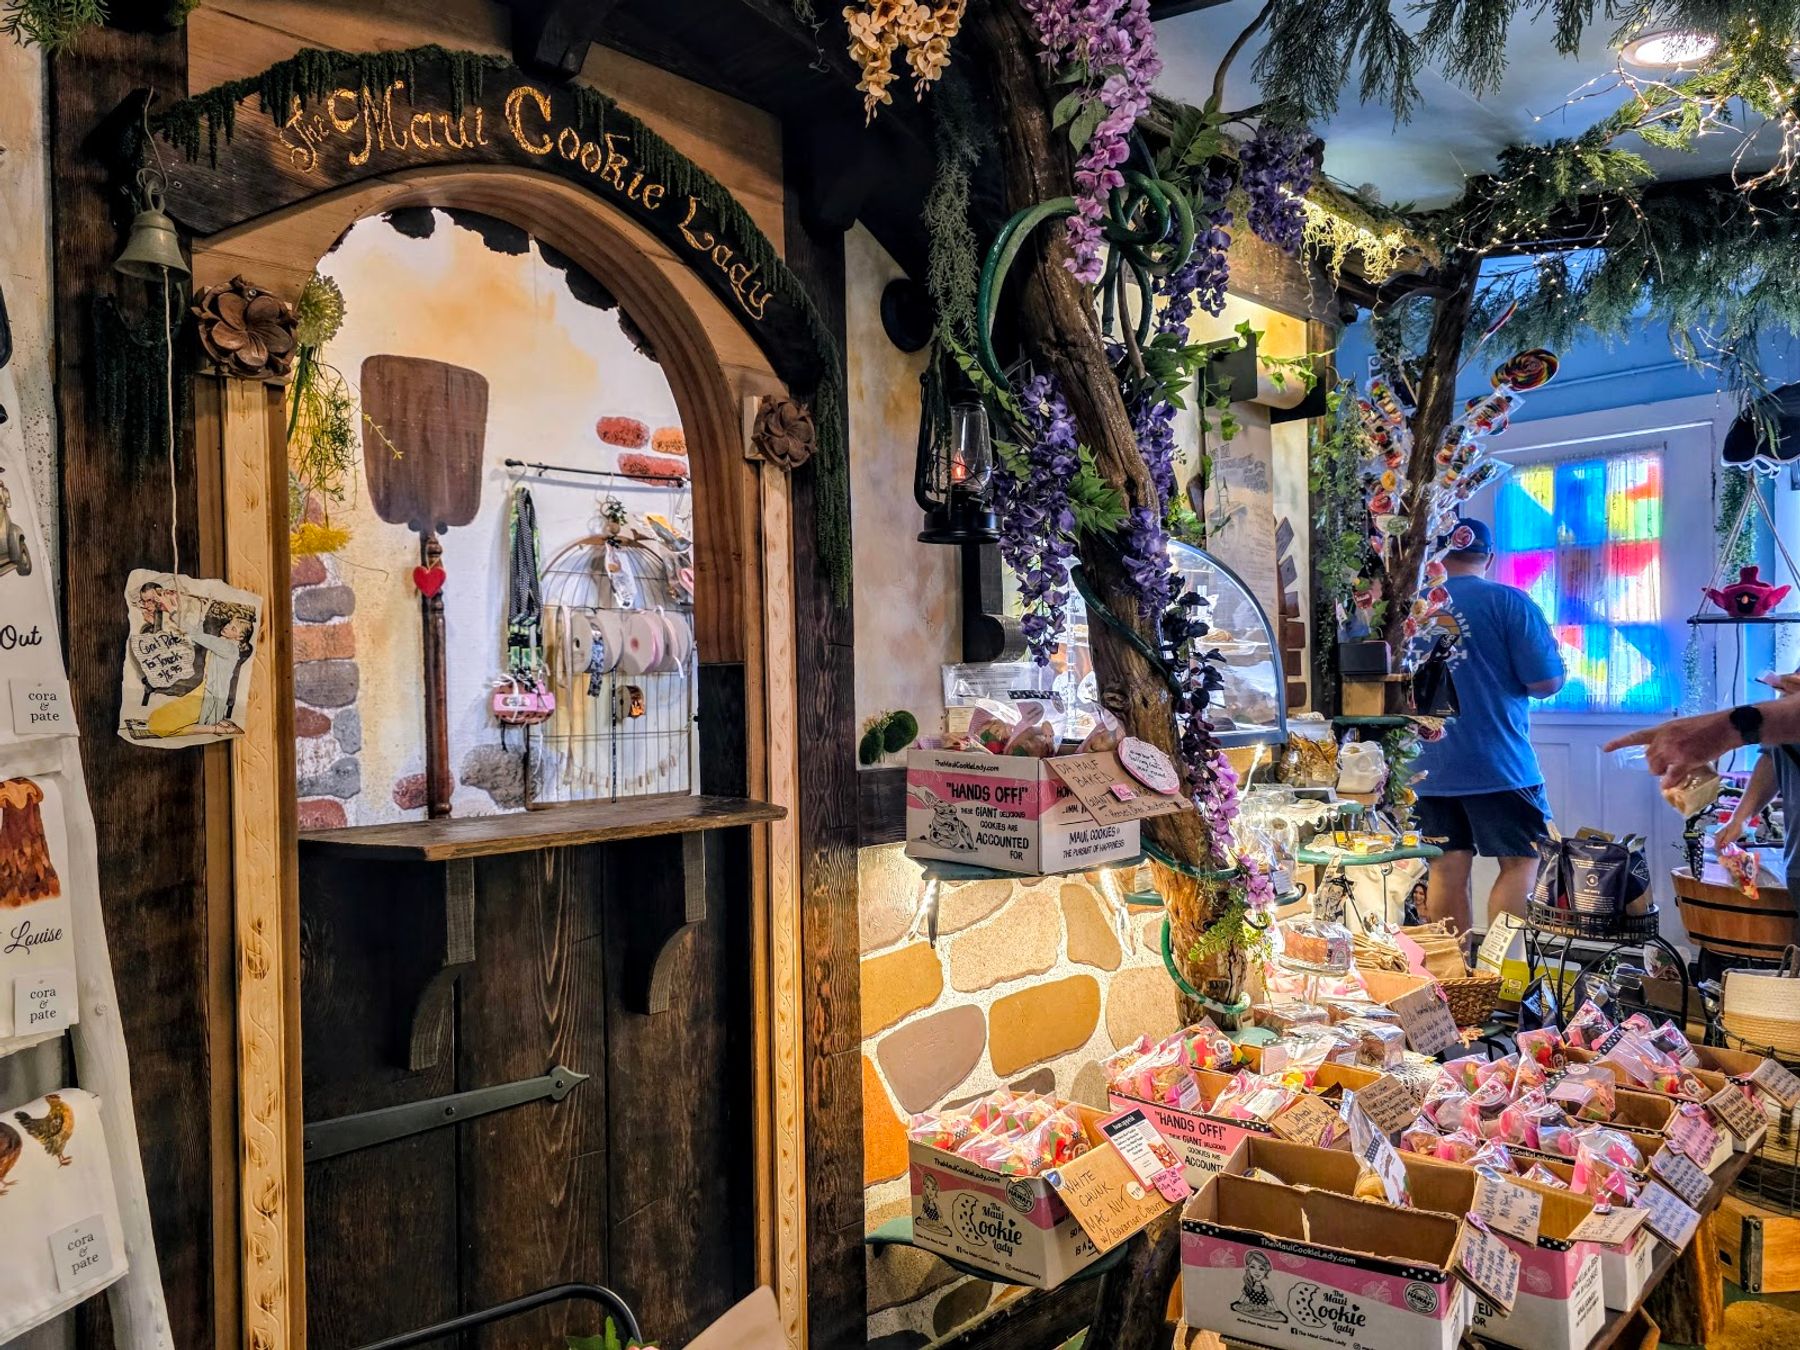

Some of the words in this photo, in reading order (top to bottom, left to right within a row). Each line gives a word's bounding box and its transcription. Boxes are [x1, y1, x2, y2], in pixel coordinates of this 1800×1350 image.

[279, 95, 330, 173] The
[327, 79, 489, 166] Maui
[504, 85, 665, 210] Cookie
[677, 194, 774, 320] Lady
[0, 624, 42, 650] Out
[28, 692, 57, 700] cora
[39, 702, 49, 711] &
[30, 713, 60, 723] pate
[1075, 759, 1099, 772] HALF
[1072, 771, 1115, 787] BAKED
[975, 806, 998, 818] GIANT
[980, 821, 1006, 832] COOKIES
[1007, 824, 1018, 832] ARE
[1090, 826, 1116, 842] COOKIES
[976, 832, 1029, 849] ACCOUNTED
[1010, 850, 1023, 860] FOR
[1063, 849, 1072, 859] THE
[1073, 845, 1093, 857] PURSUIT
[1092, 844, 1100, 853] OF
[1100, 839, 1125, 852] HAPPINESS
[4, 920, 63, 955] Louise
[30, 988, 57, 999] cora
[39, 1000, 48, 1009] &
[30, 1009, 57, 1024] pate
[1182, 1135, 1202, 1147] GIANT
[1184, 1155, 1224, 1173] ACCOUNT
[1063, 1169, 1096, 1194] WHITE
[1078, 1181, 1115, 1208] CHUNK
[1107, 1183, 1131, 1216] NUT
[982, 1205, 1004, 1220] Maui
[990, 1202, 1001, 1211] The
[67, 1233, 95, 1251] cora
[993, 1238, 1013, 1257] Lady
[79, 1246, 88, 1257] &
[1260, 1237, 1356, 1265] TheMauiCookieLady.com
[71, 1254, 100, 1275] pate
[1323, 1292, 1348, 1306] Maui
[1333, 1290, 1344, 1298] The
[1332, 1321, 1355, 1337] Lady
[1472, 1315, 1487, 1328] OR
[1318, 1335, 1334, 1343] Cookie
[1335, 1339, 1347, 1347] Lady
